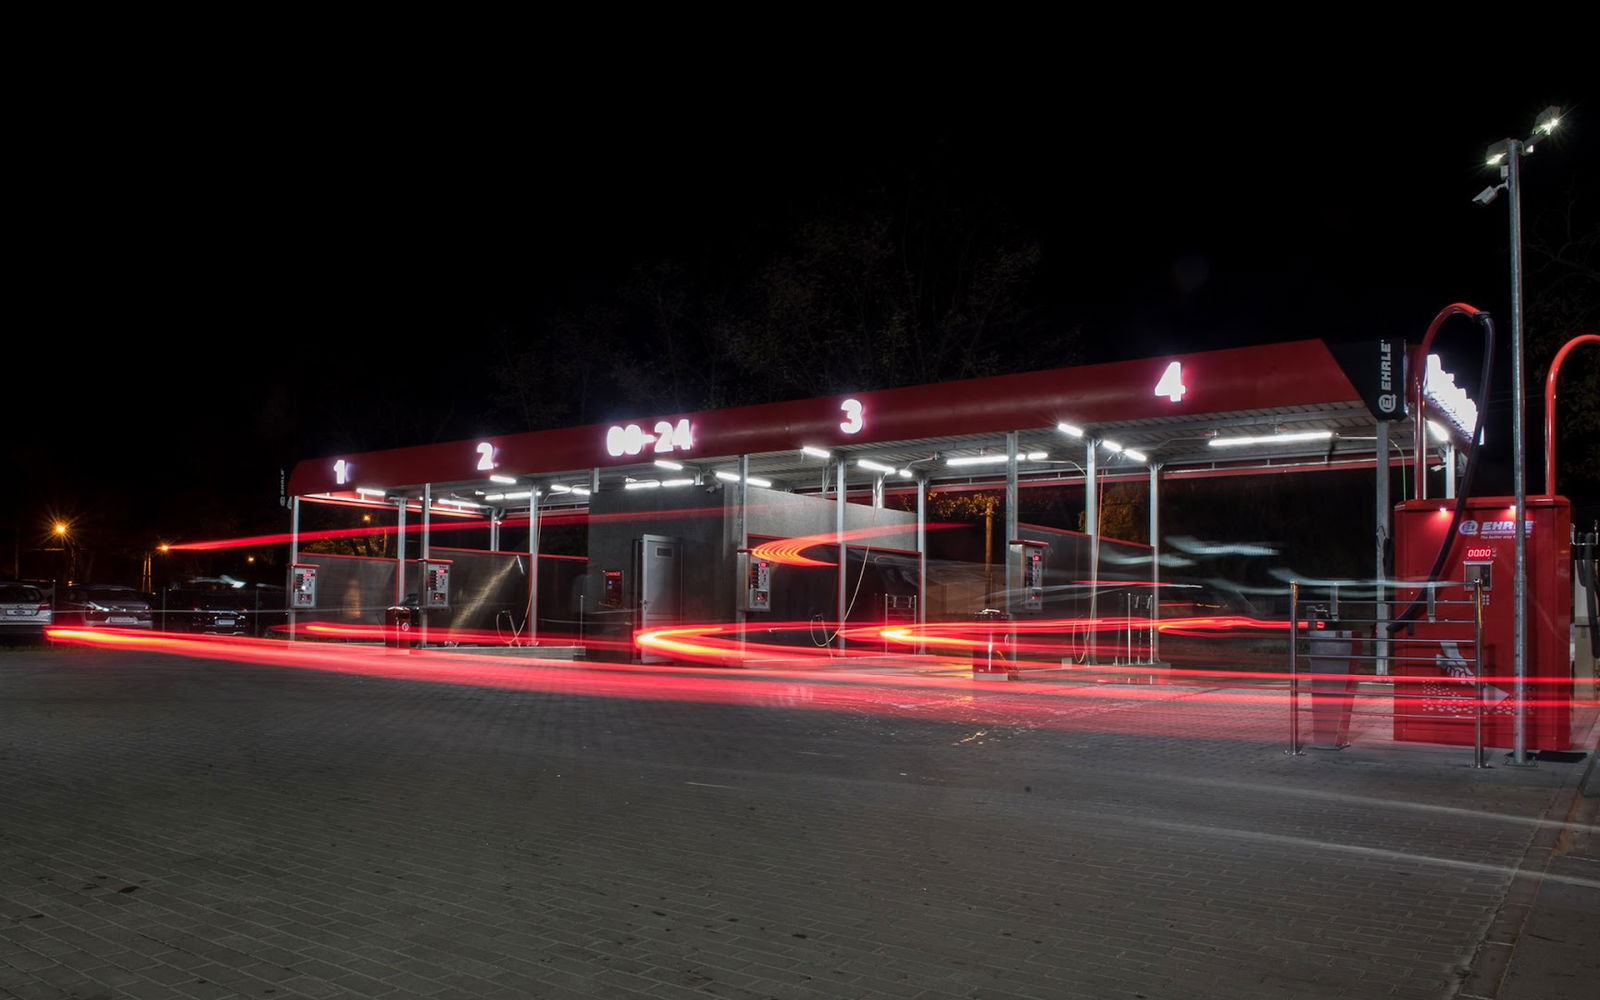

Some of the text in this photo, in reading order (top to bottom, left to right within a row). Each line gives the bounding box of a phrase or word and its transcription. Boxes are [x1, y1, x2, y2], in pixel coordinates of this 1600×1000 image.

[1154, 361, 1186, 402] 4
[1381, 343, 1391, 391] EHRLE
[840, 398, 863, 434] 3
[333, 459, 346, 485] 1
[476, 442, 494, 470] 2
[1481, 521, 1534, 531] EHRE
